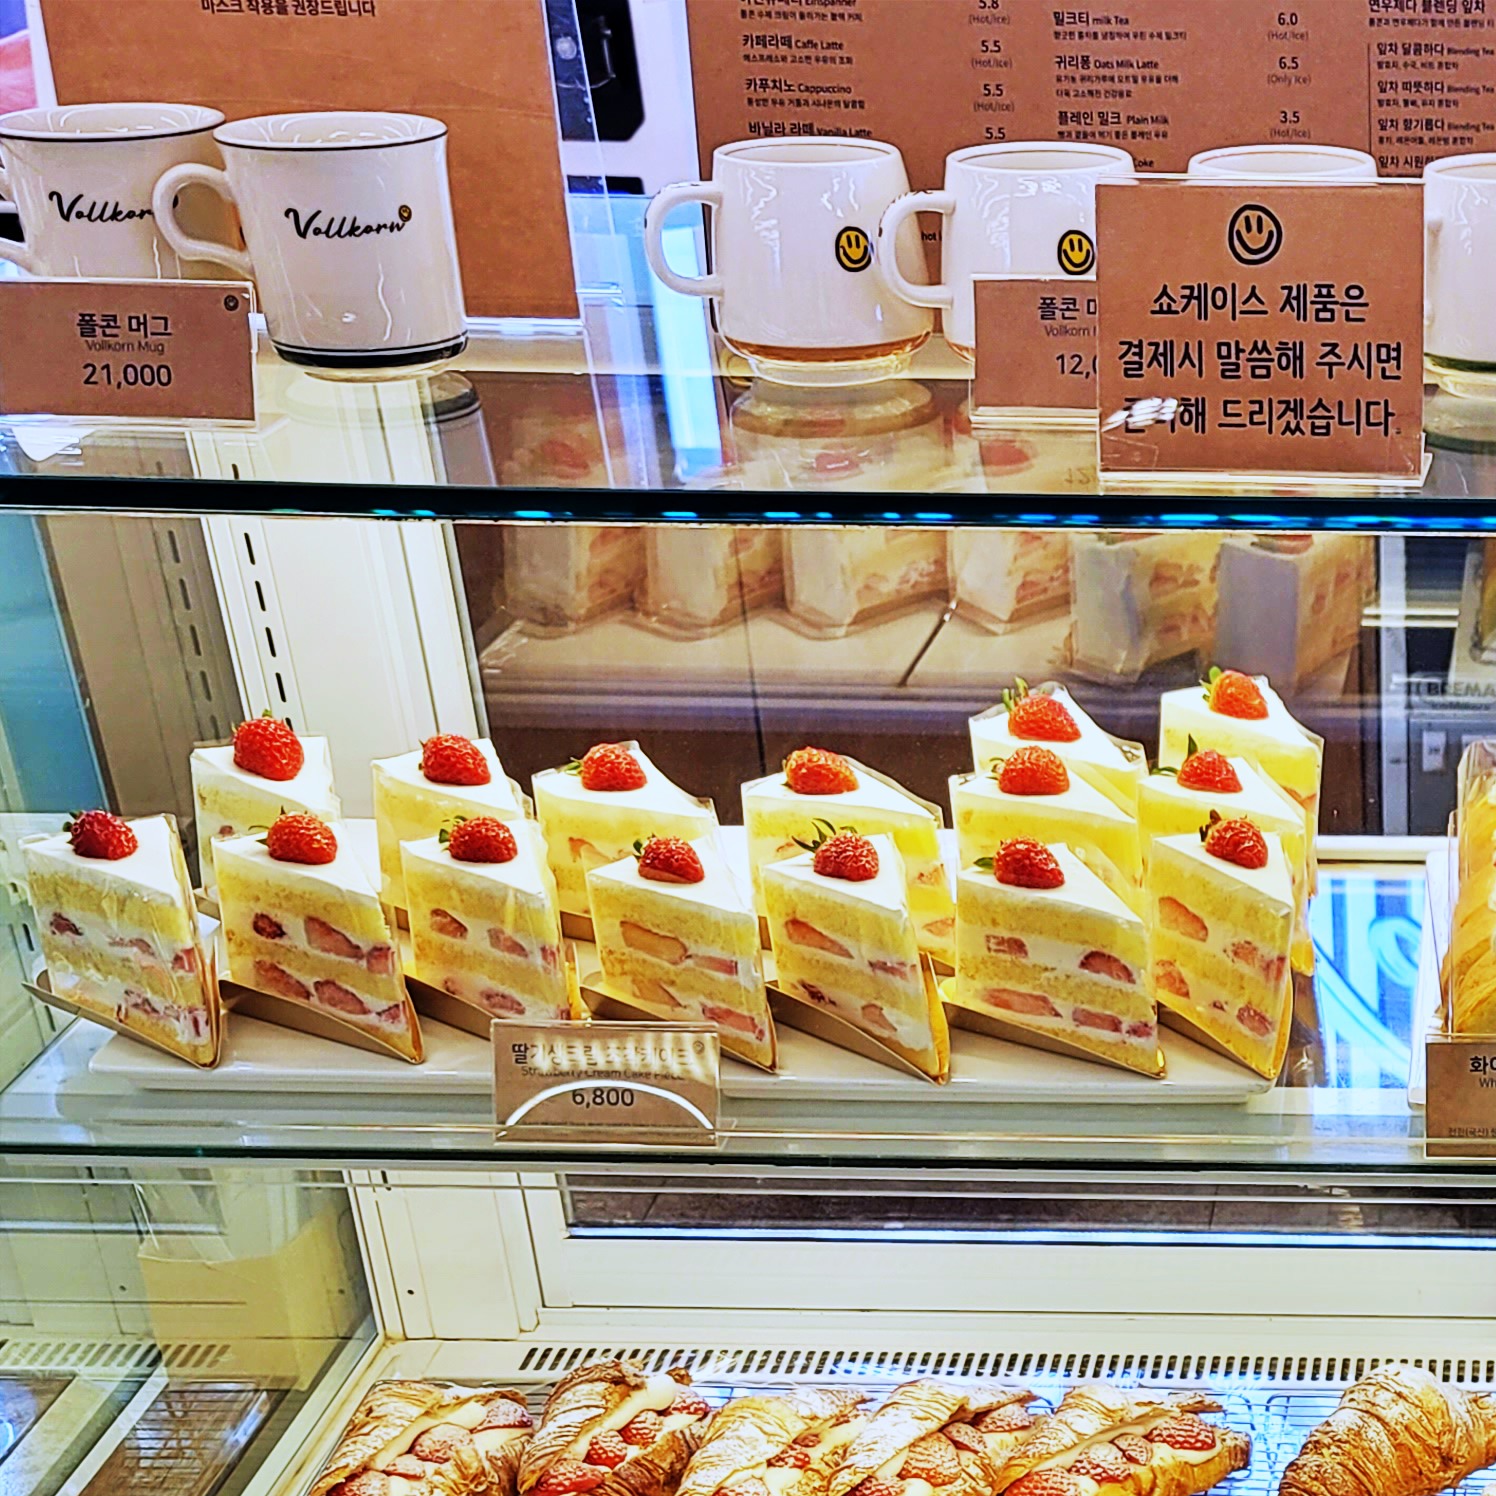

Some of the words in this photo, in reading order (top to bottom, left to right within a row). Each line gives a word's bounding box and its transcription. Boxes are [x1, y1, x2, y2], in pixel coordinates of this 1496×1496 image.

[293, 0, 376, 17] 권장드립니다
[1053, 11, 1089, 27] 밀크티
[1114, 16, 1130, 25] Tea
[1278, 12, 1298, 26] 6.0
[742, 34, 793, 50] 카페라떼
[821, 40, 844, 50] Latte
[981, 40, 1002, 53] 5.5
[1377, 43, 1398, 56] 잎차
[1402, 43, 1444, 56] 달콤하다
[1136, 60, 1159, 70] Latte
[1279, 57, 1299, 70] 6.5
[745, 78, 796, 93] 카푸치노
[798, 83, 852, 94] Cappuccino
[983, 84, 1004, 97] 5.5
[1378, 81, 1398, 94] 잎차
[1402, 81, 1444, 94] 따뜻하다
[1058, 111, 1094, 126] 플레인
[1098, 111, 1122, 126] 밀크
[1127, 116, 1149, 125] Plain
[1280, 111, 1300, 124] 3.5
[1378, 118, 1398, 132] 잎차
[1403, 118, 1445, 132] 향기롭다
[749, 121, 785, 136] 바닐라
[789, 122, 814, 136] 라떼
[985, 127, 1006, 140] 5.5
[1379, 155, 1399, 168] 잎차
[49, 190, 154, 223] Vollkor
[284, 208, 406, 240] Vollkorn
[1038, 297, 1080, 320] 폴콘
[1150, 282, 1269, 322] 쇼케이스
[1279, 283, 1370, 323] 제품은
[77, 313, 121, 338] 폴콘
[128, 314, 173, 338] 머그
[1044, 325, 1090, 337] Vollkorn
[85, 340, 134, 352] Vollkorn
[138, 341, 165, 355] Mug
[1118, 340, 1204, 379] 결제시
[1216, 340, 1304, 380] 말씀해
[1315, 341, 1402, 380] 주시면
[82, 363, 173, 390] 21,000
[1218, 398, 1402, 438] 드리겠습니다.
[572, 1087, 635, 1109] 6,800
